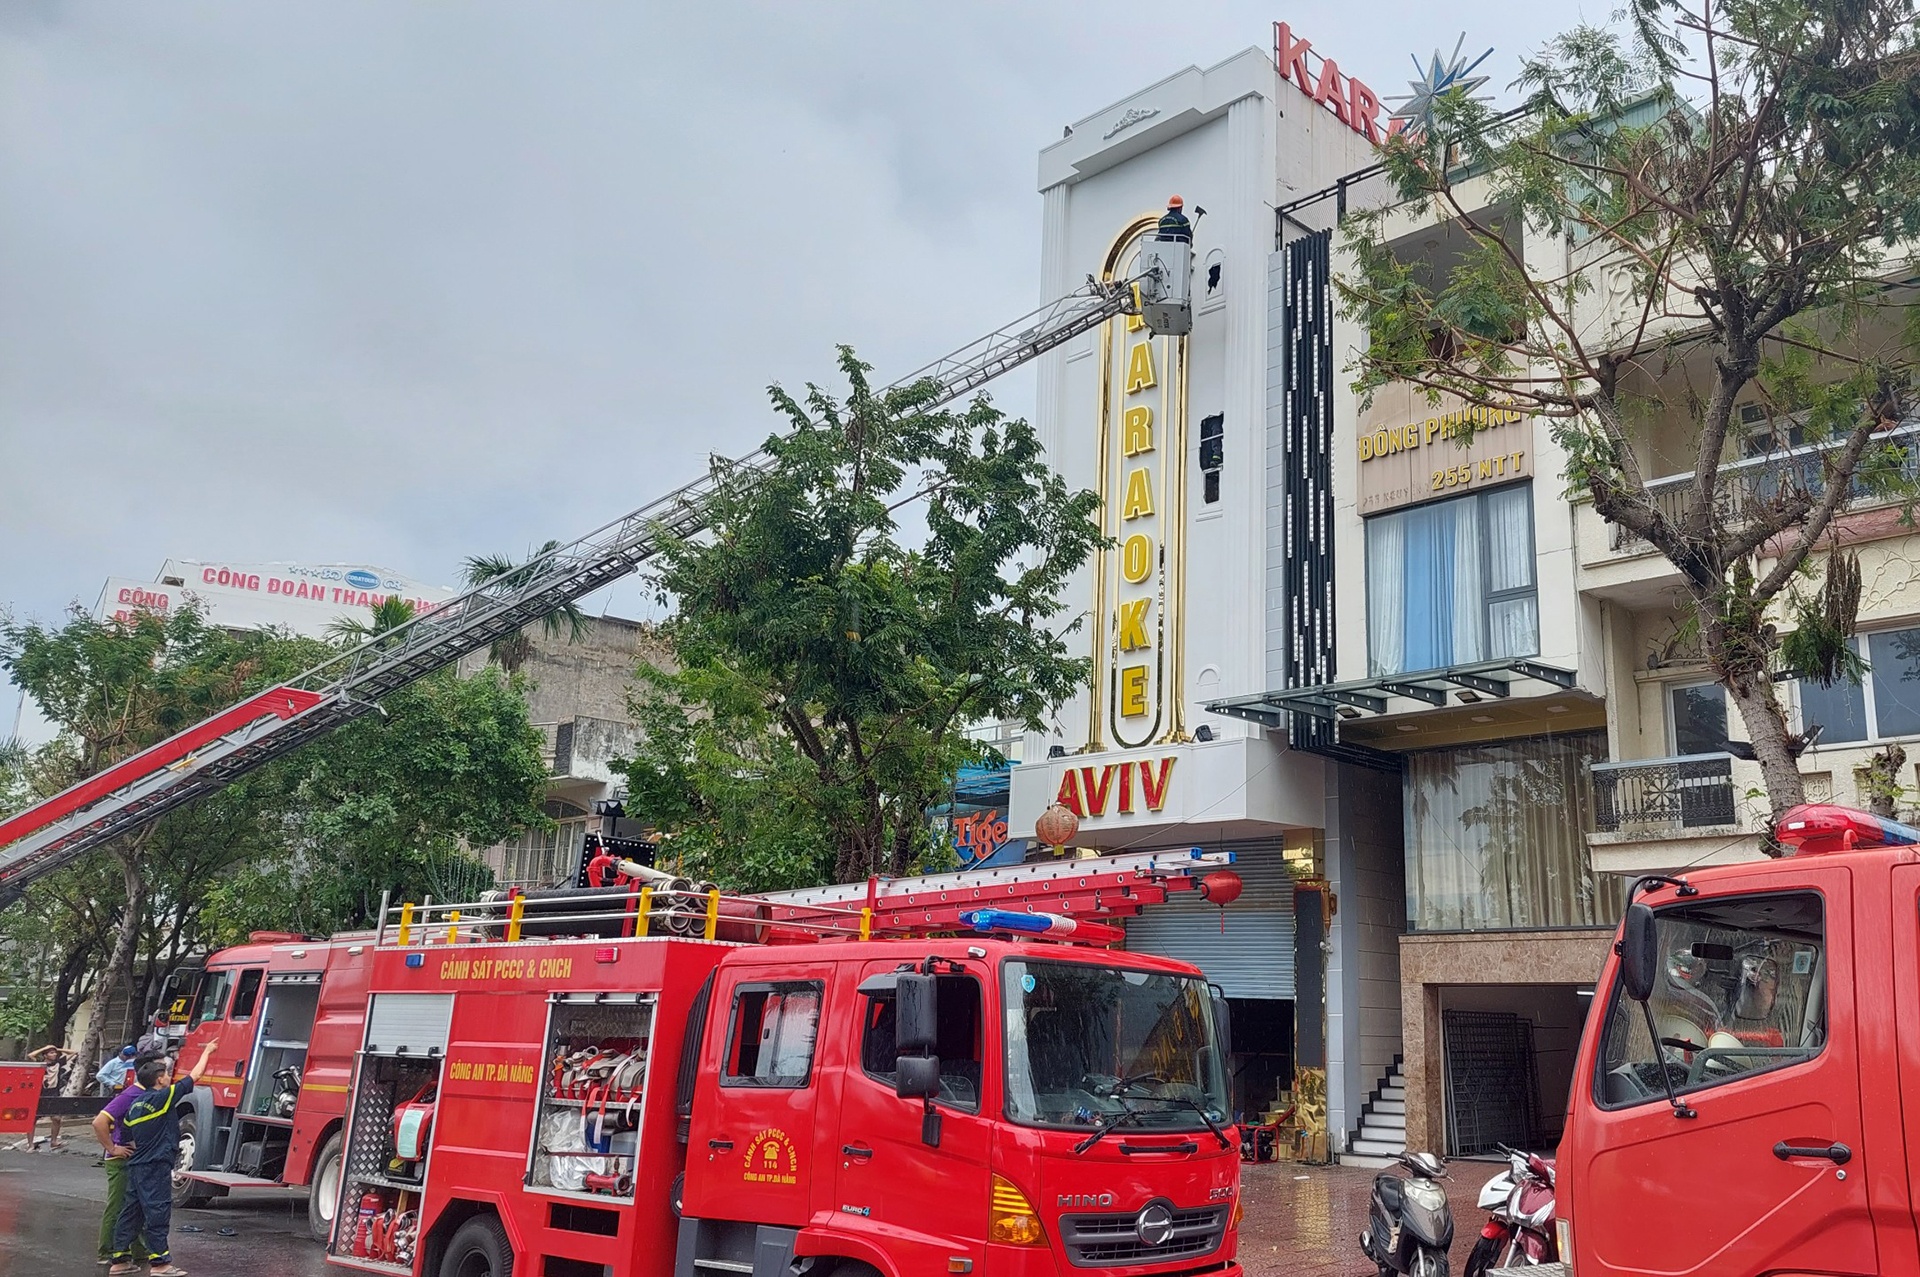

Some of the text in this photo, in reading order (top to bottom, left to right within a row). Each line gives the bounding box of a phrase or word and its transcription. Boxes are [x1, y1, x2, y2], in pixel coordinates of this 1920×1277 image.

[1359, 424, 1419, 462] ĐÔNG
[1432, 451, 1524, 491] 255 NTT
[118, 586, 169, 610] CÔNG
[202, 566, 260, 592] CÔNG
[266, 579, 326, 602] ĐOÀN
[332, 587, 402, 612] THAN
[1057, 757, 1178, 818] AVIV
[953, 809, 1008, 860] Tige
[440, 953, 572, 980] CẢNH SÁT PCCC & CNCH
[449, 1058, 471, 1080] CÔNG
[471, 1063, 485, 1081] AN
[763, 1160, 778, 1169] 114
[1057, 1194, 1113, 1208] HINO
